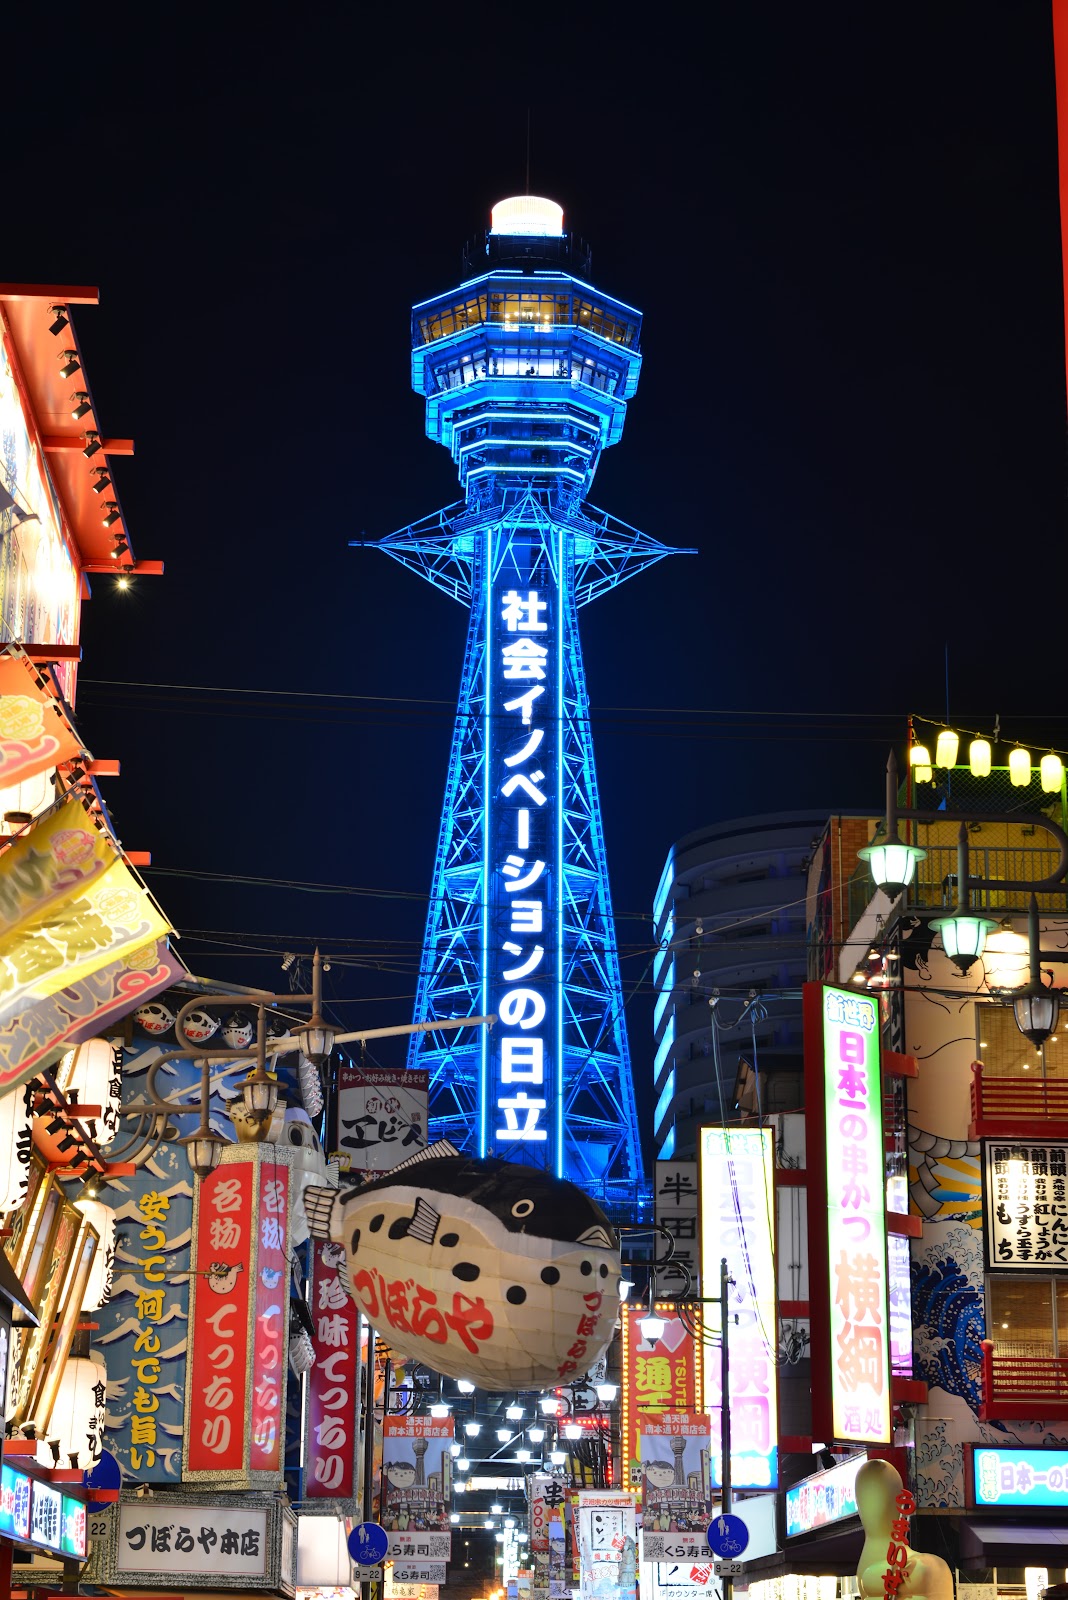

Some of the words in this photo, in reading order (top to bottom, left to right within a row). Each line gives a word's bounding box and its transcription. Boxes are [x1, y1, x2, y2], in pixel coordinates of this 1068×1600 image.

[496, 590, 549, 1140] 社会イノベーションの日立
[826, 996, 875, 1031] 新世界
[340, 1115, 424, 1149] エビス
[837, 1030, 872, 1242] 日本一の串かつ
[209, 1178, 243, 1250] 名物
[260, 1179, 286, 1251] 名物
[655, 1172, 697, 1283] 半田屋
[996, 1202, 1014, 1261] もち
[1015, 1203, 1034, 1261] うずら玉子
[1033, 1203, 1053, 1261] 紅しょうが
[1051, 1204, 1068, 1262] にんにく
[130, 1190, 171, 1470] 安うて何んでも旨い
[352, 1266, 494, 1355] づぼらや
[834, 1248, 884, 1397] 横綱
[202, 1303, 239, 1455] てっちり
[254, 1303, 282, 1455] てっちり
[315, 1277, 350, 1490] 珍味てっちり
[389, 1426, 449, 1437] 南本通り商店会
[644, 1424, 707, 1435] 南本通り商店会
[843, 1405, 882, 1435] 酒処
[543, 1481, 565, 1509] 串
[125, 1524, 261, 1557] づぼらや本店
[664, 1545, 713, 1558] くら寿司
[393, 1570, 430, 1580] くら寿司
